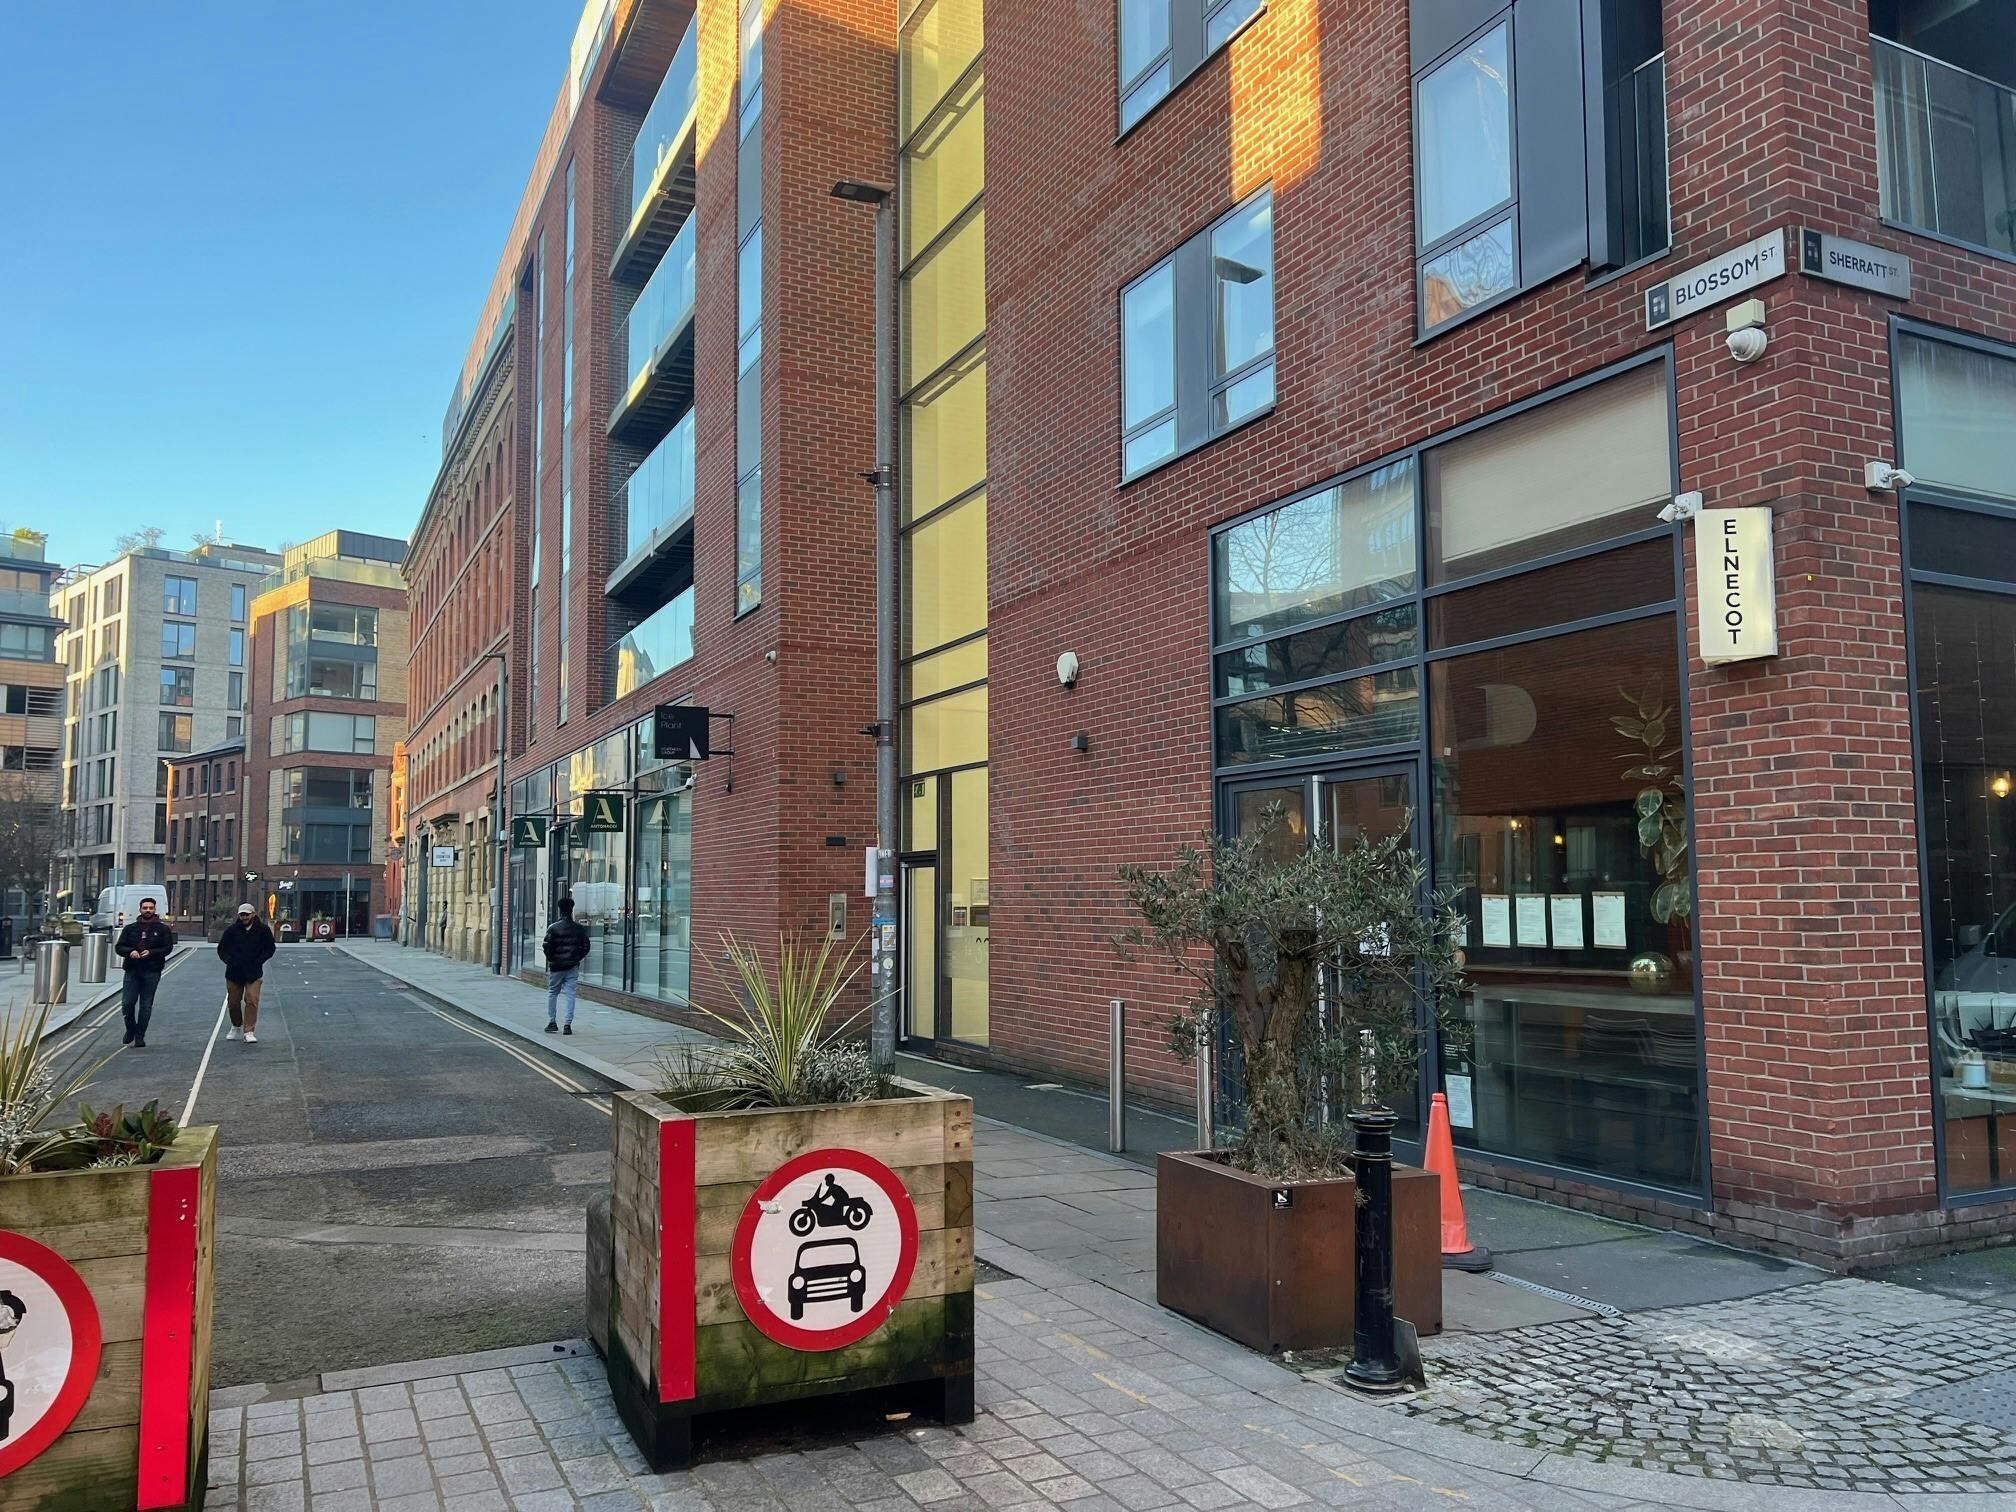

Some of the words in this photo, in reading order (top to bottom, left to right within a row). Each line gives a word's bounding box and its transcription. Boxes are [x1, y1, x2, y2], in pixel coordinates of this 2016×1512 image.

[1829, 251, 1887, 278] SHERRATT
[1676, 254, 1759, 305] BLOSSOM
[1723, 519, 1743, 644] ELNECOT
[660, 712, 674, 720] Ice
[660, 720, 682, 729] Plant
[592, 798, 617, 824] A
[521, 821, 541, 842] A
